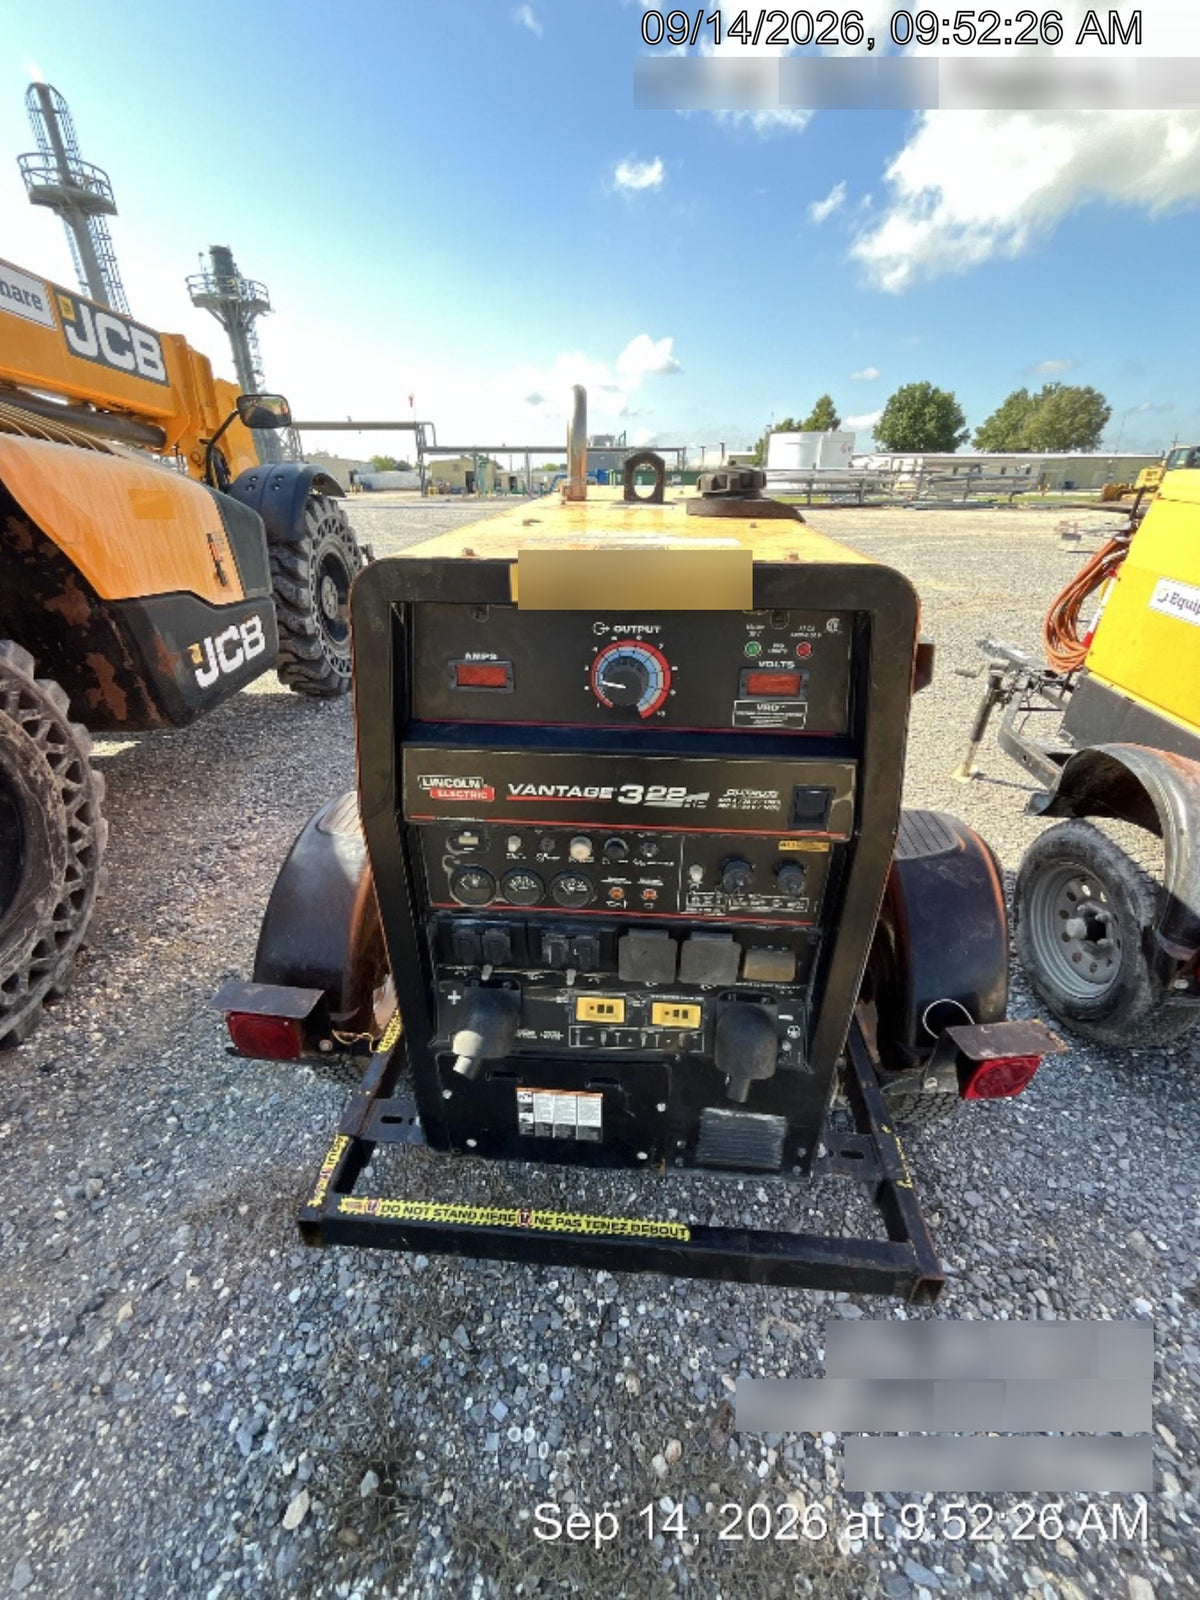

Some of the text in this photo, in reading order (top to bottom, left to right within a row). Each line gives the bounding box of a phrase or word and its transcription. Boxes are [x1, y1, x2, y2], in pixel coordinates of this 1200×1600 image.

[64, 303, 166, 381] JCB
[613, 625, 661, 634] OUTPUT
[195, 614, 266, 688] JCB
[758, 660, 796, 669] VOLTS
[422, 777, 482, 789] LINCOLN
[437, 789, 488, 799] ELECTRIC
[508, 783, 614, 799] VANTAGE
[617, 784, 687, 805] 328
[380, 1204, 688, 1237] DO NOT STAND HERE NE PAS TENEZ DEBOUT
